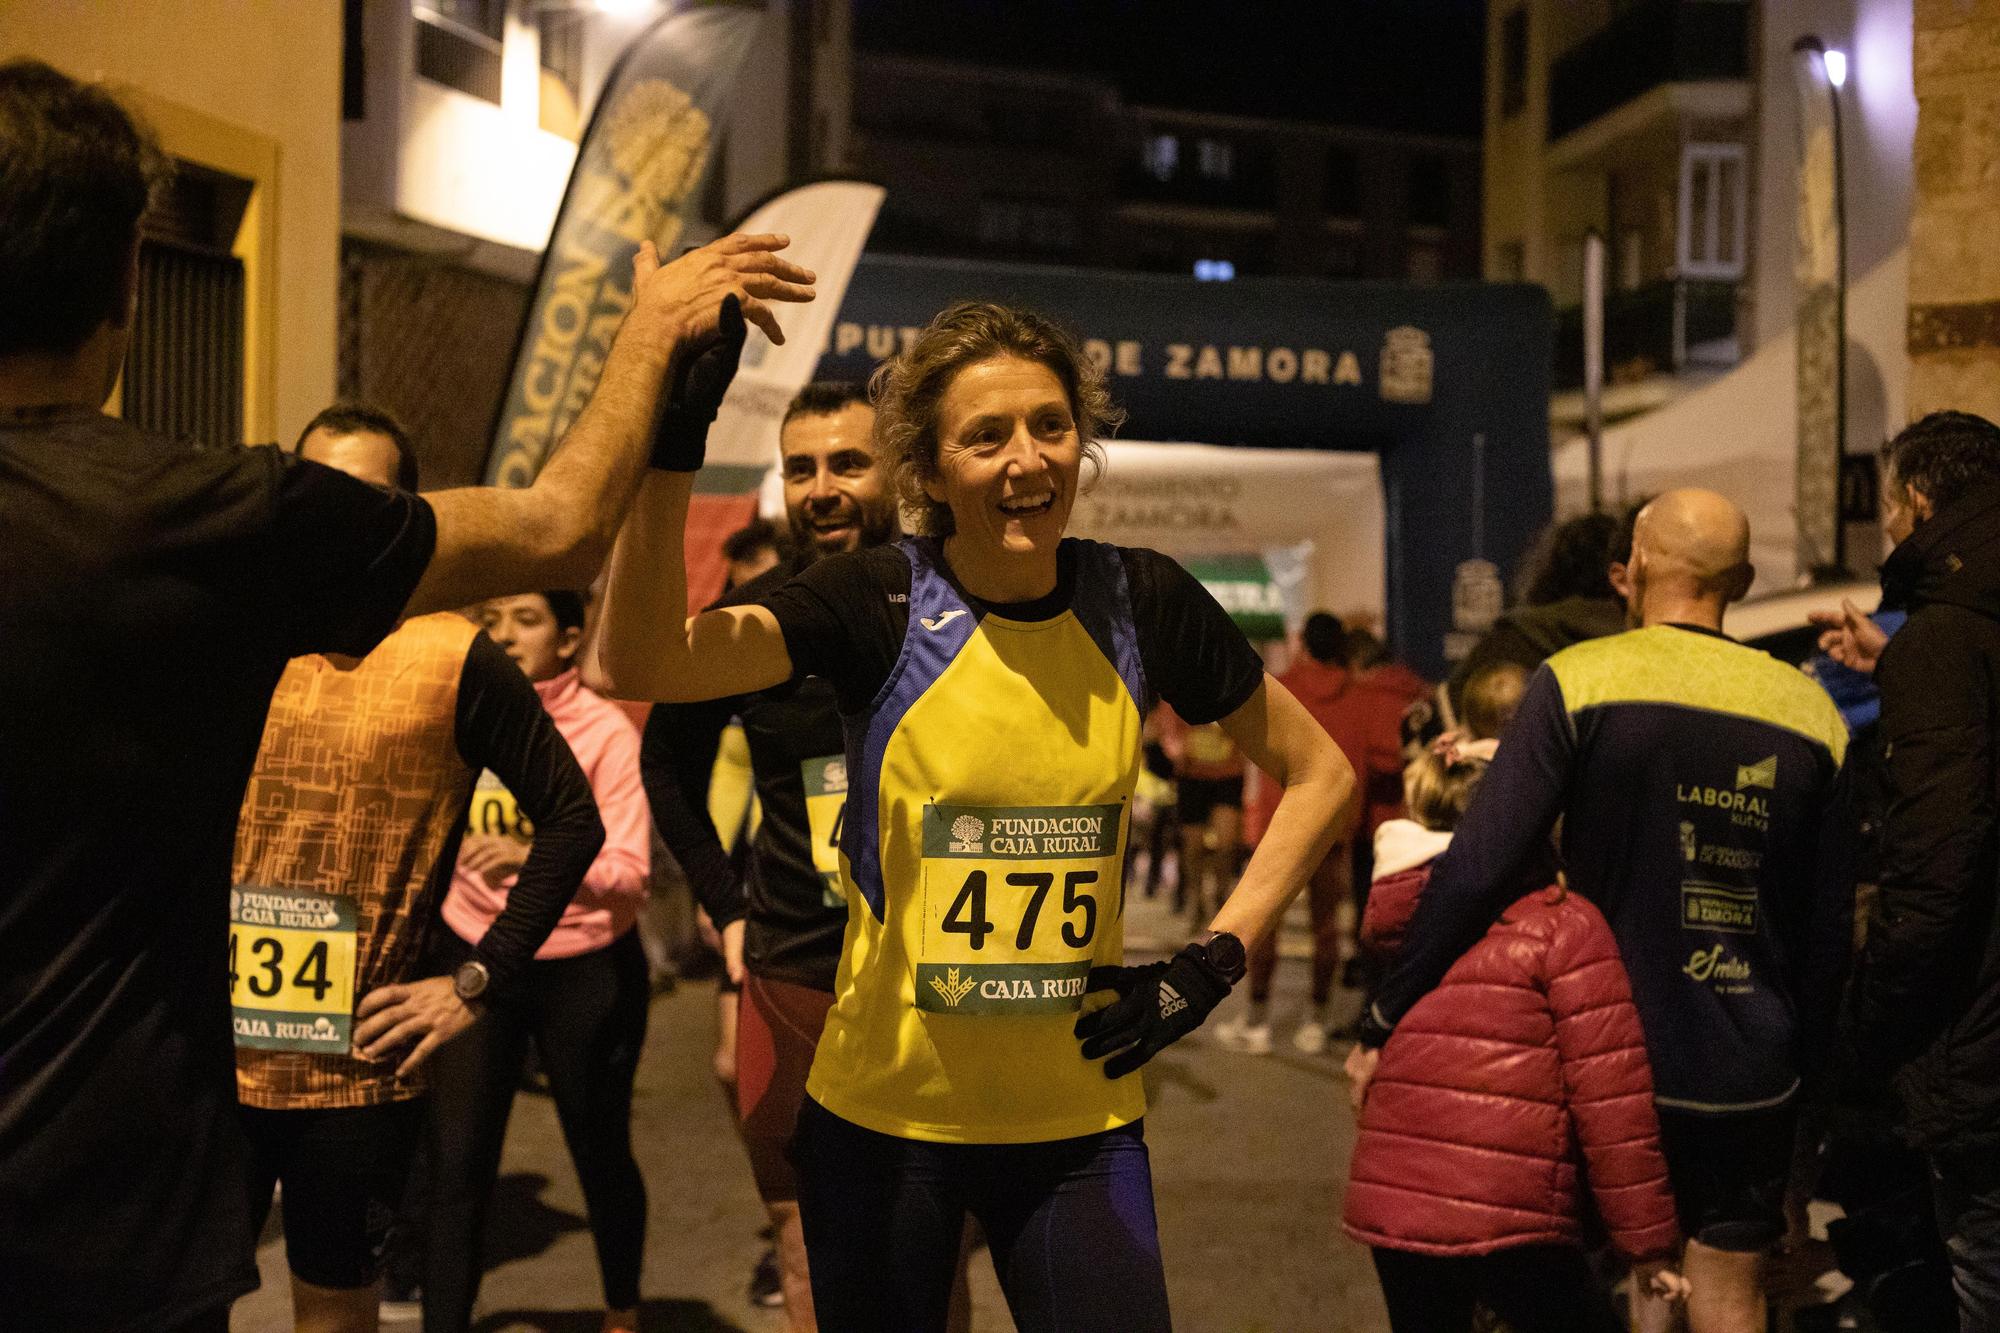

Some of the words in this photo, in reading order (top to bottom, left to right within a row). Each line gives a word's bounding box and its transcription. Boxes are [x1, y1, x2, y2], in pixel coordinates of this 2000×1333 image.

[1084, 339, 1142, 377] DE
[1164, 344, 1361, 387] ZAMORA
[1677, 784, 1770, 818] LABORAL
[990, 816, 1102, 836] FUNDACION
[990, 838, 1037, 855] CAJA
[1043, 836, 1100, 854] RURAL
[243, 892, 337, 914] FUNDACION
[941, 869, 1099, 950] 475
[241, 909, 275, 924] CAJA
[279, 912, 334, 928] RURA
[979, 980, 1037, 1000] CAJA
[233, 1016, 271, 1038] CAJA
